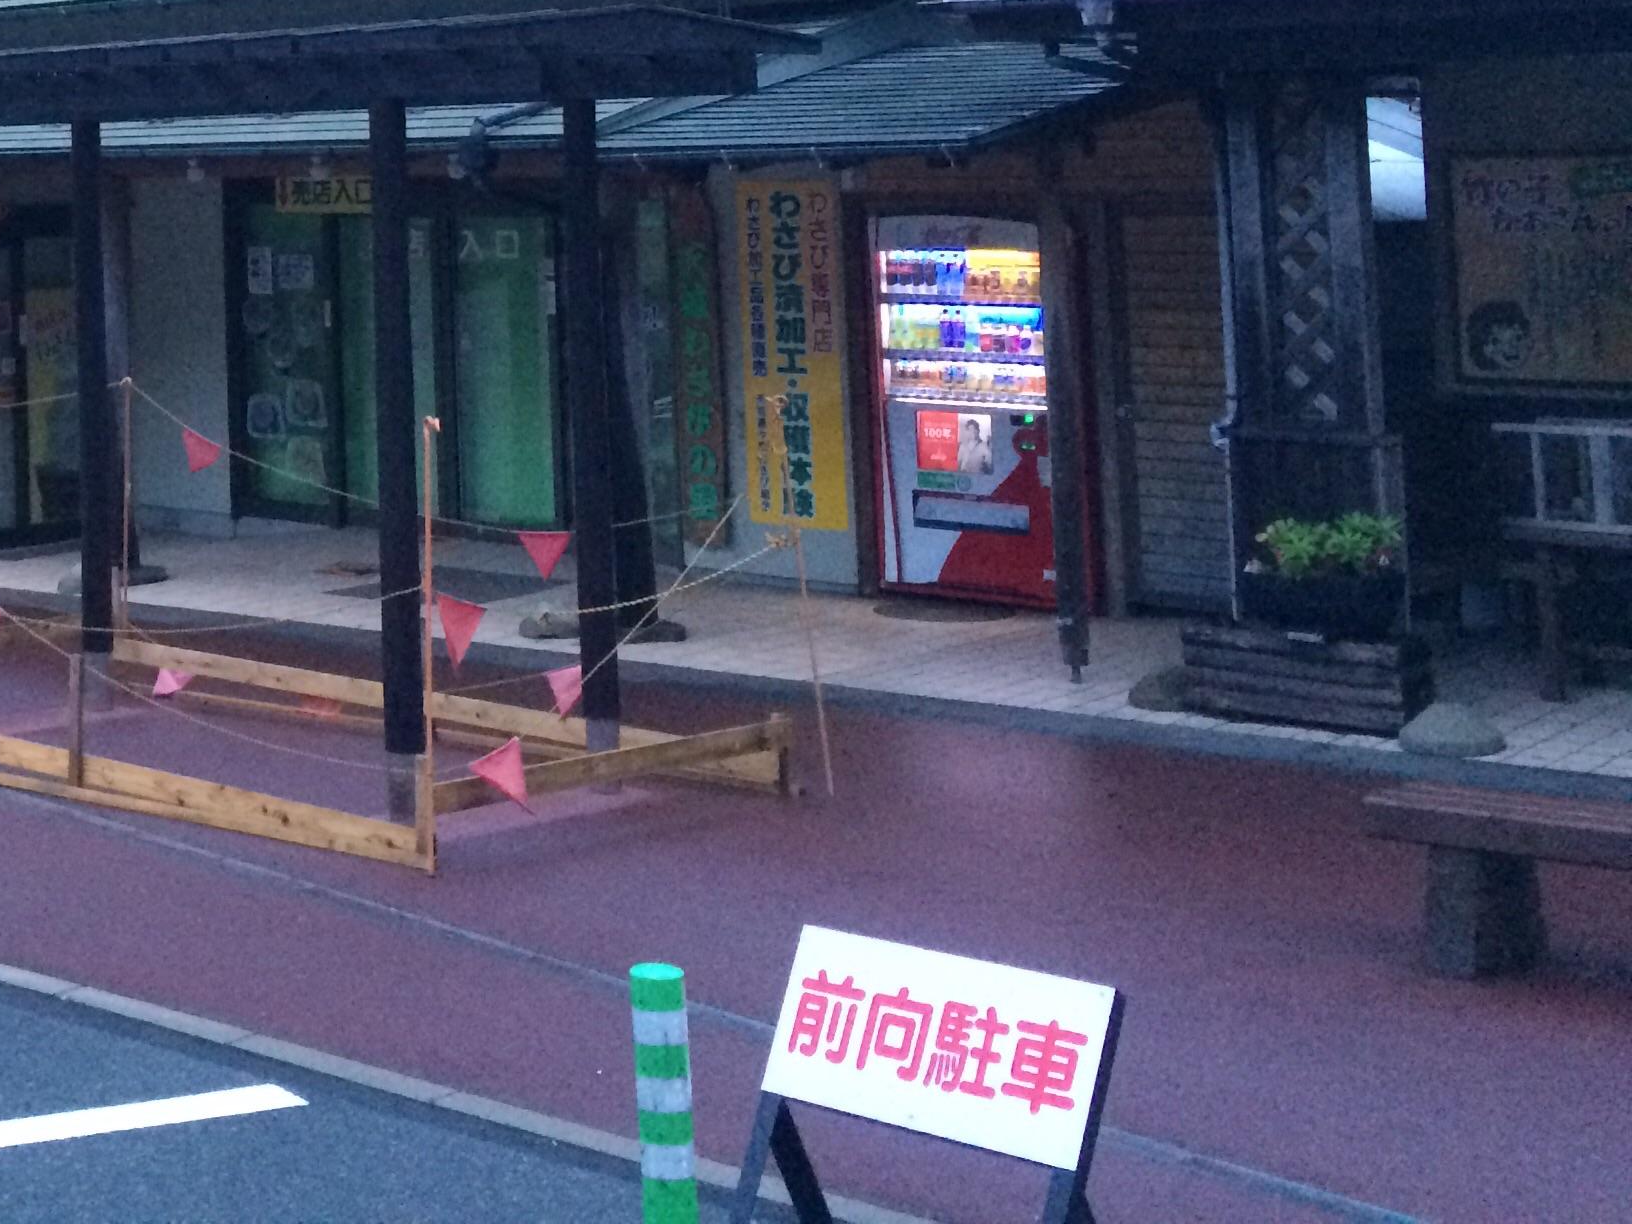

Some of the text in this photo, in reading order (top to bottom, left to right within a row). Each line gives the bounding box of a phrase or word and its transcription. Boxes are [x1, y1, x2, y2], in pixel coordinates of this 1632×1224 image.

[292, 179, 373, 206] 売店入口
[787, 968, 1089, 1115] 前向駐車
